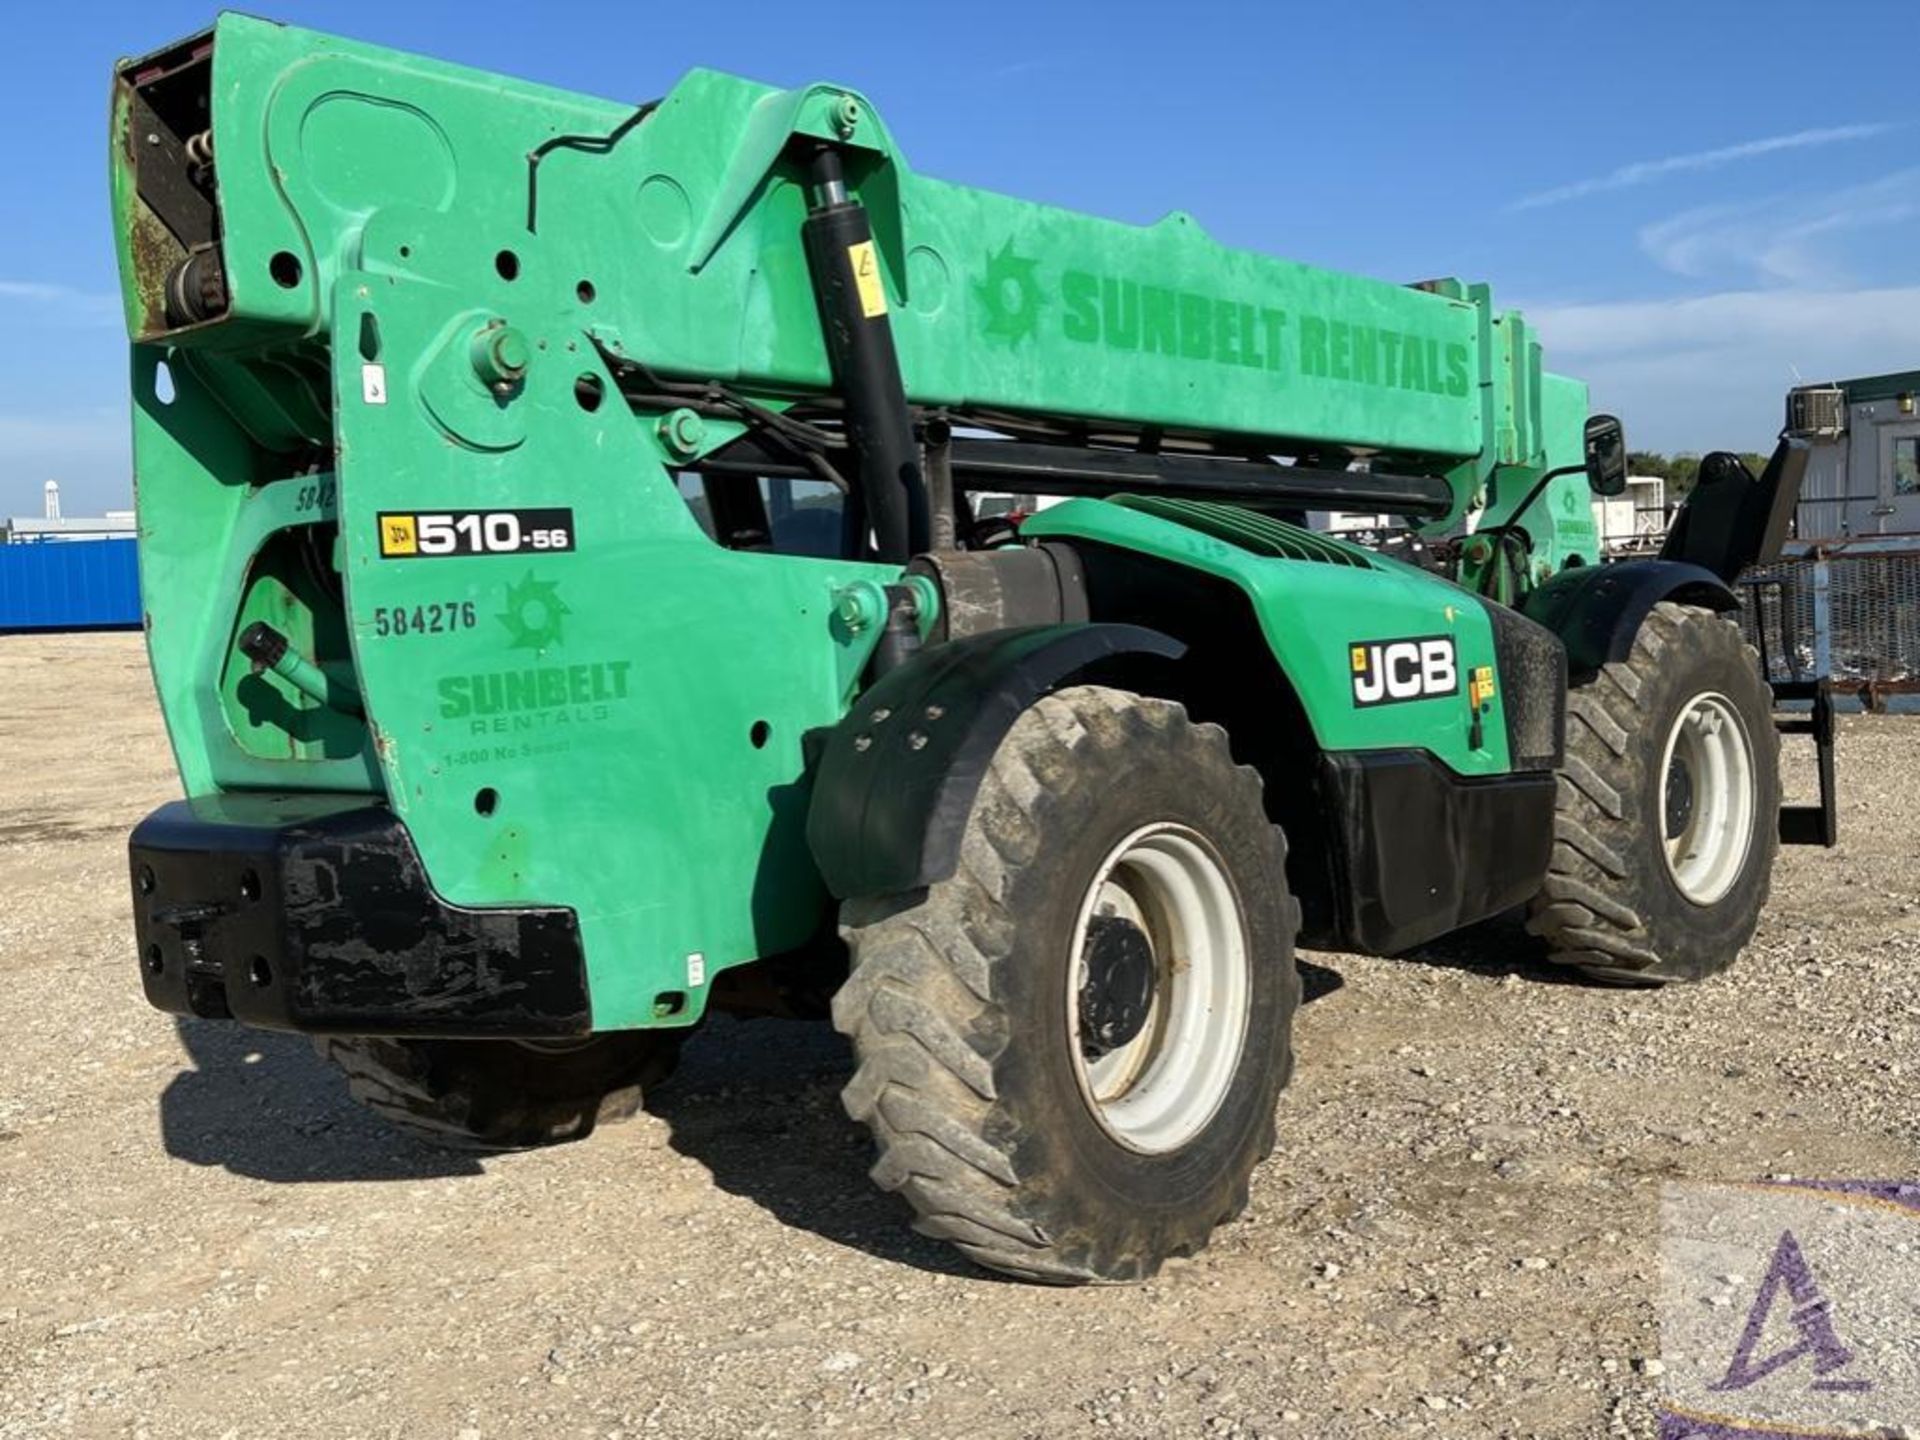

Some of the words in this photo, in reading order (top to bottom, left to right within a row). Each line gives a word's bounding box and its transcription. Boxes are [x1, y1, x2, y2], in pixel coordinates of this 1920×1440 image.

[1061, 270, 1287, 371] SUNBELT
[1299, 315, 1469, 398] RENTALS
[295, 482, 334, 512] 5842
[417, 513, 568, 554] 510-56
[375, 602, 477, 637] 584276
[437, 661, 631, 720] SUNBELT
[1354, 639, 1457, 703] JCB
[470, 705, 609, 735] RENTALS
